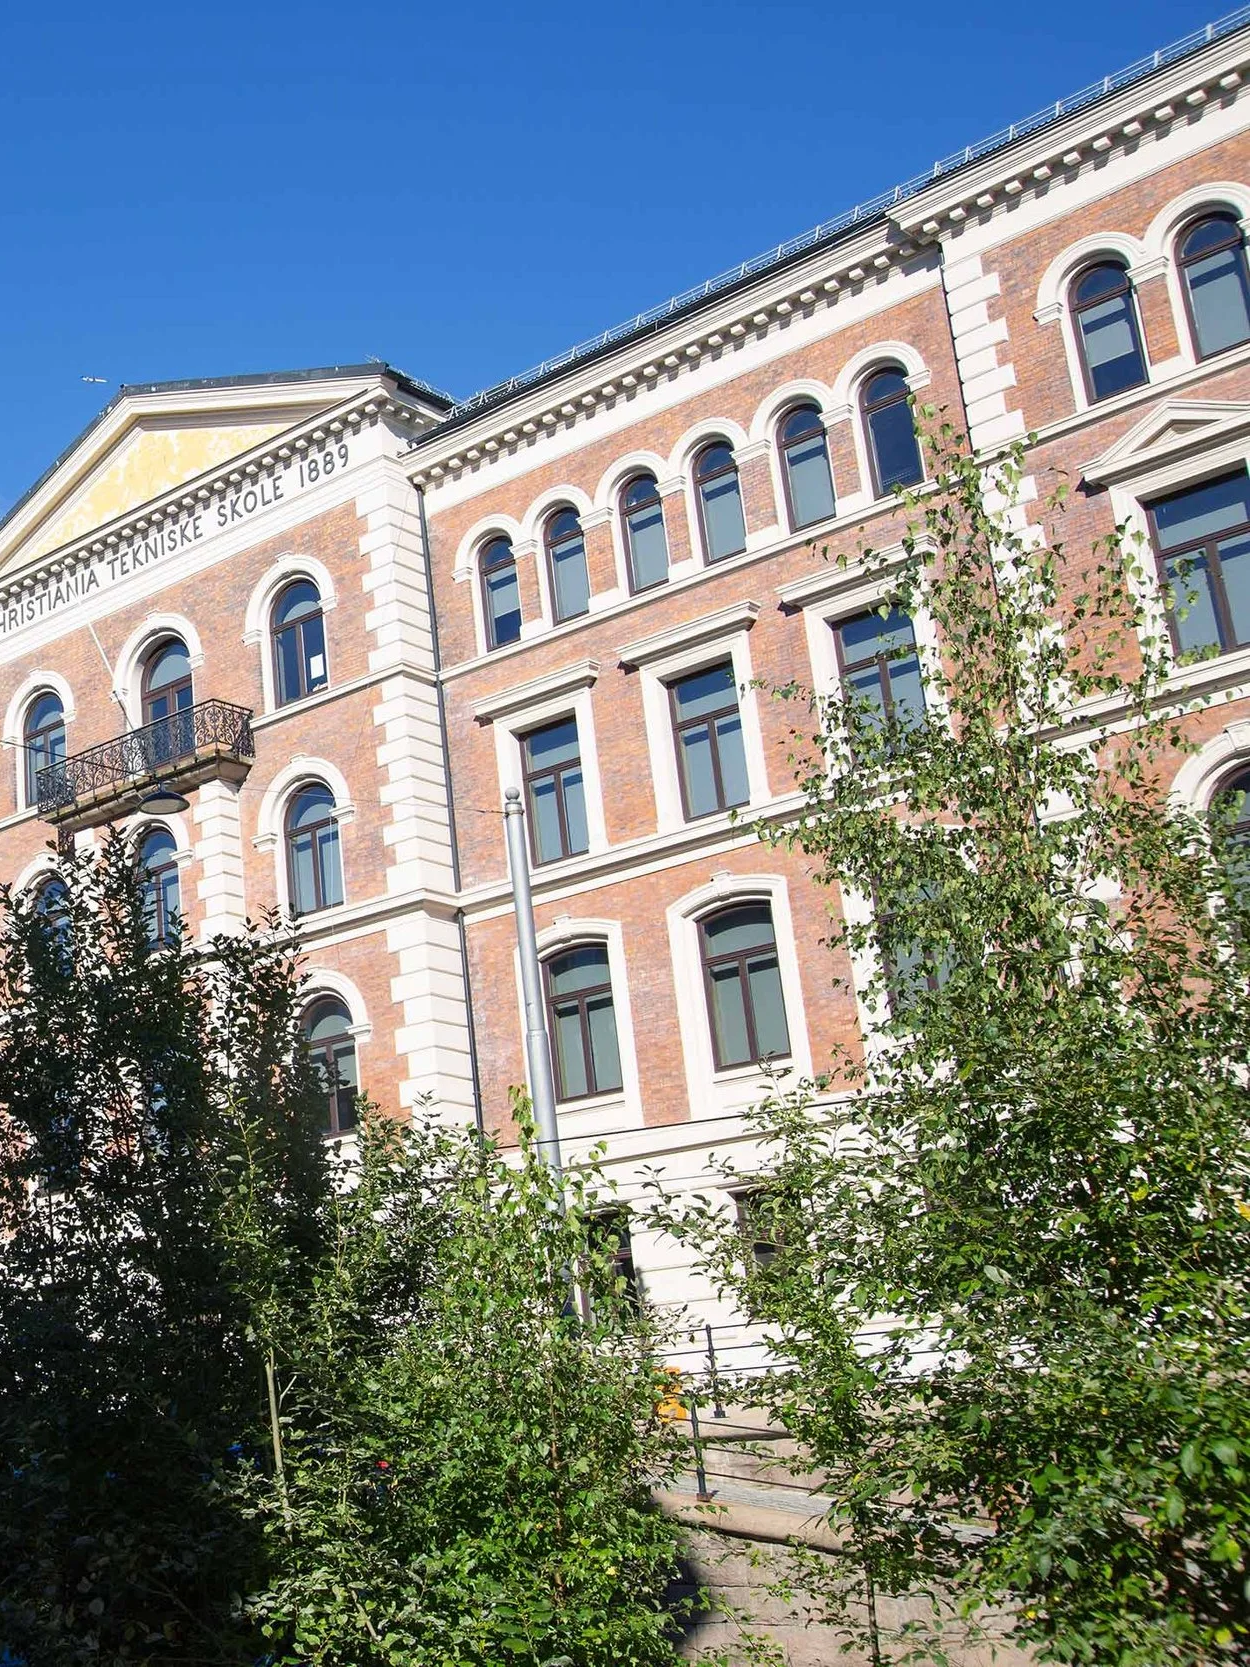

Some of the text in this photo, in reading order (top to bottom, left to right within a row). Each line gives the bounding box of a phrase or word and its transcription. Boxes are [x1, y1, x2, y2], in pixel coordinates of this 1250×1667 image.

[106, 515, 204, 582] TEKNISKE
[217, 475, 284, 527] SKOLE
[299, 444, 350, 488] 1889
